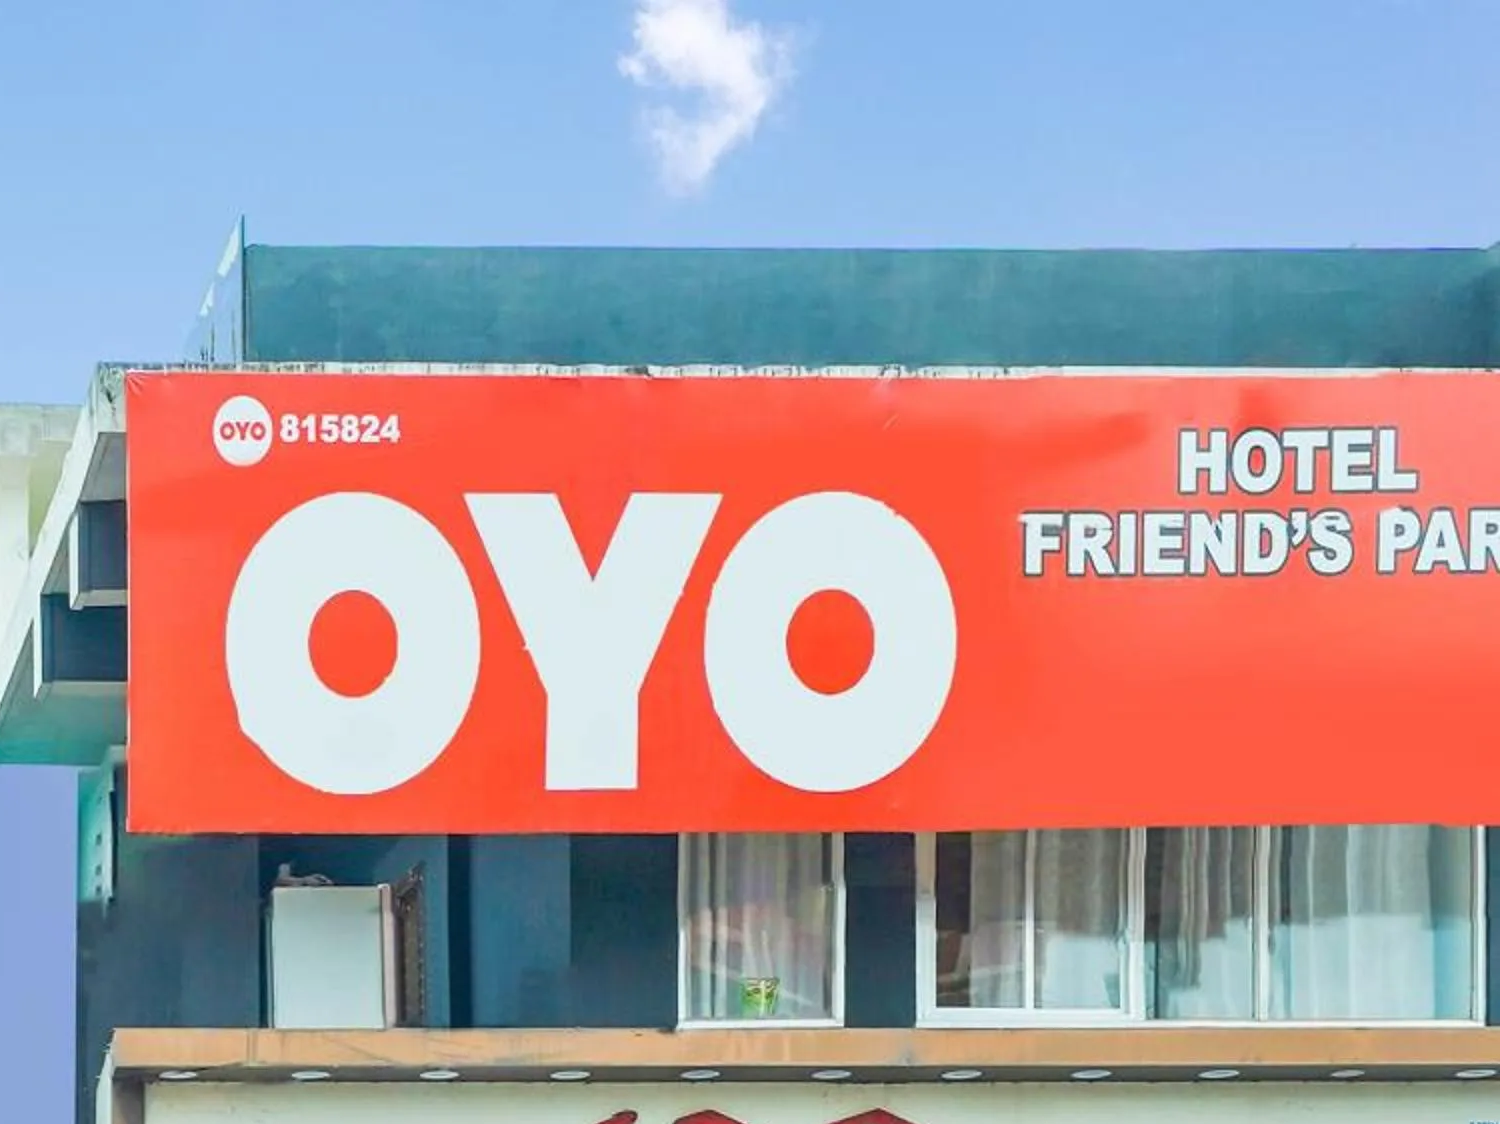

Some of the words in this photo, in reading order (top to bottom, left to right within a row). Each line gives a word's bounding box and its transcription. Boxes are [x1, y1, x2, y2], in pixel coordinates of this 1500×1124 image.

[219, 421, 267, 441] OYO
[279, 413, 401, 443] 815824
[1177, 426, 1420, 495] HOTEL
[1020, 505, 1354, 577] FRIEND'S
[225, 490, 958, 795] OYO
